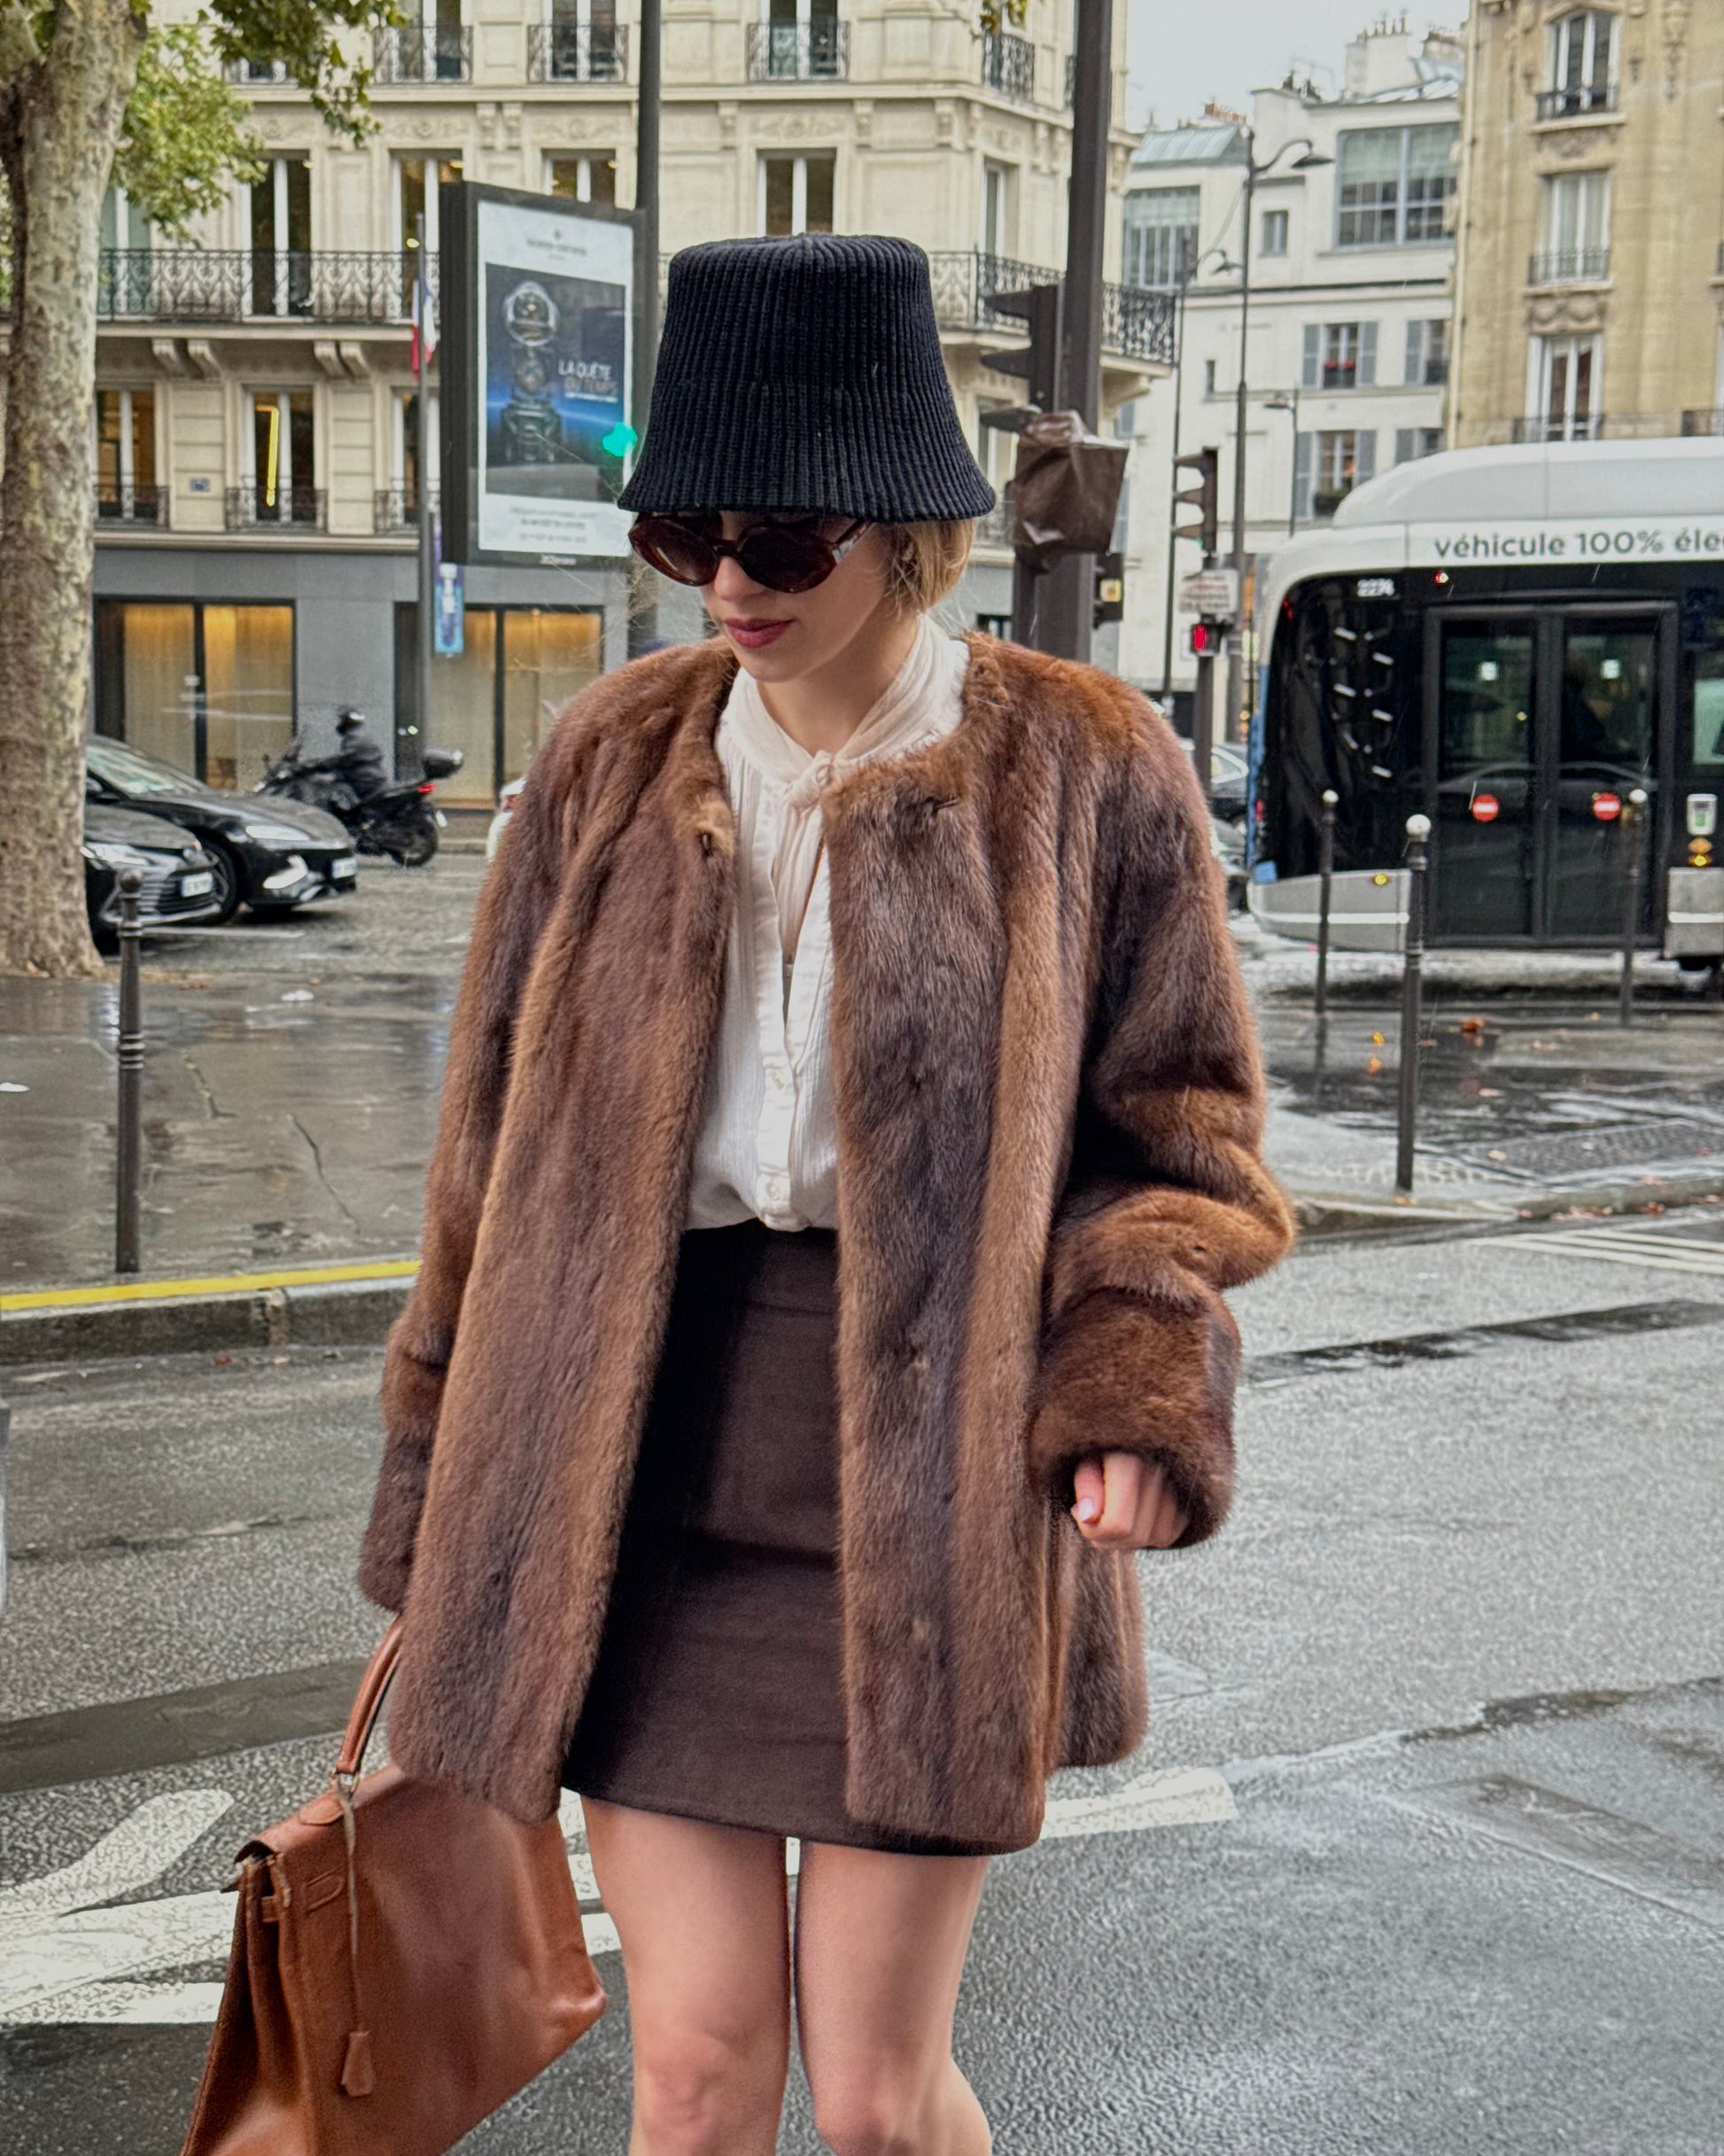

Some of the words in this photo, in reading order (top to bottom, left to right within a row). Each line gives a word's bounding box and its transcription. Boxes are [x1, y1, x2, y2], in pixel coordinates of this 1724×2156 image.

[1434, 532, 1565, 558] véhicule
[1576, 530, 1664, 554] 100%
[1674, 526, 1724, 553] éle
